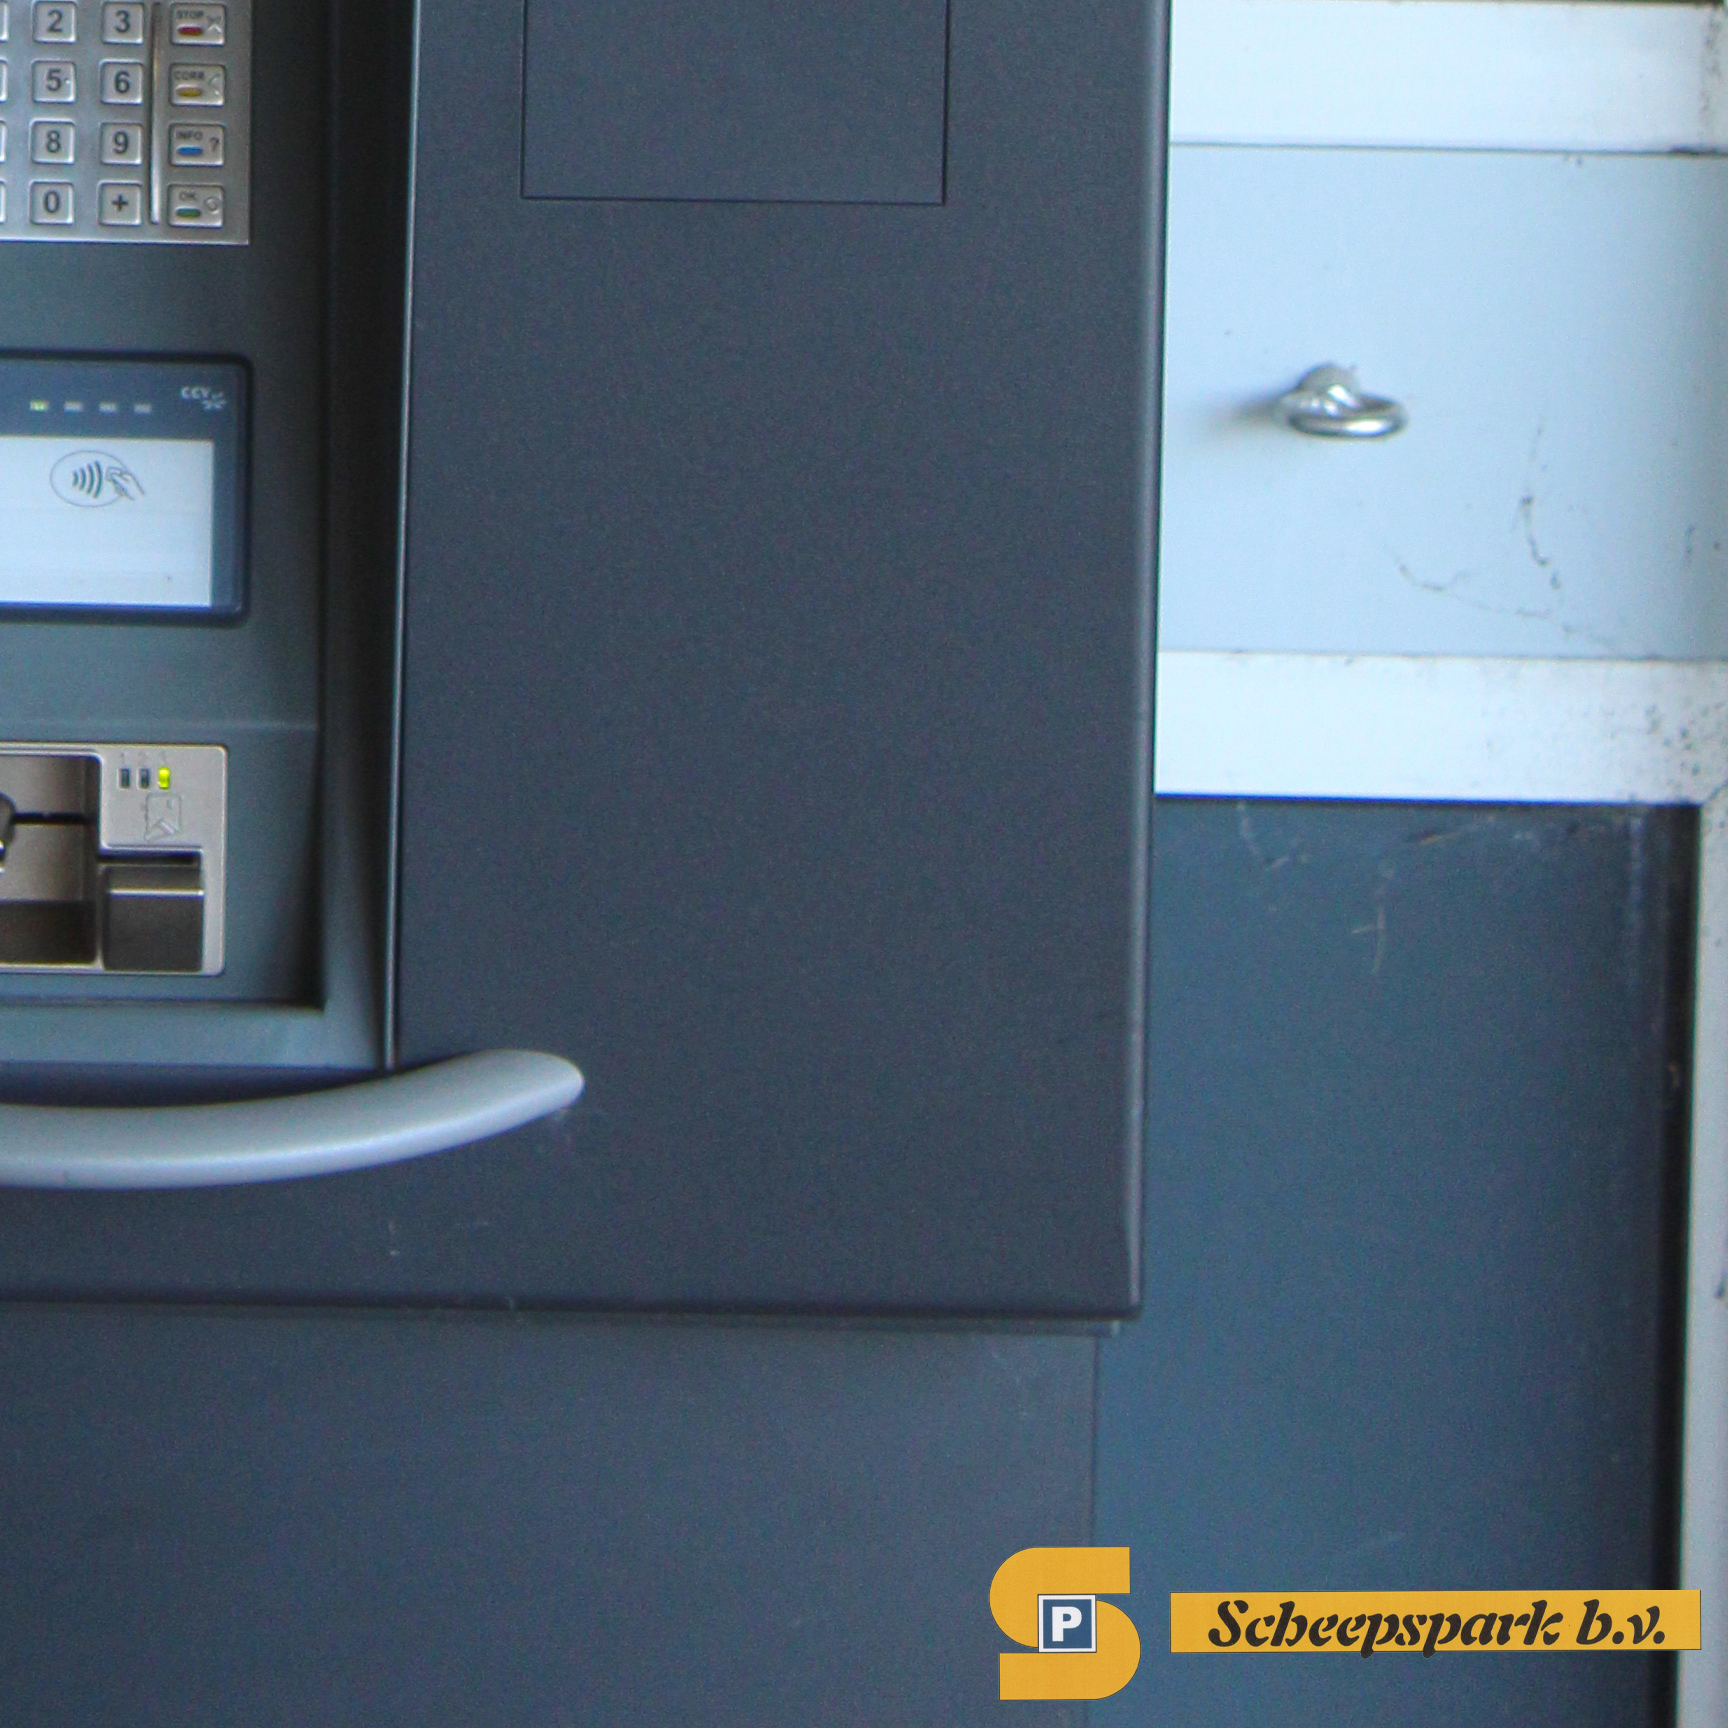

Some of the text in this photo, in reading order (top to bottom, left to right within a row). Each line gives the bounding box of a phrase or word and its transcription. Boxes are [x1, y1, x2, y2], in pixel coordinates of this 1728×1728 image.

[47, 10, 63, 33] 2
[115, 10, 131, 33] 3
[46, 69, 62, 92] 5
[114, 71, 130, 94] 6
[46, 130, 61, 153] 8
[113, 131, 129, 154] 9
[43, 190, 60, 213] 0
